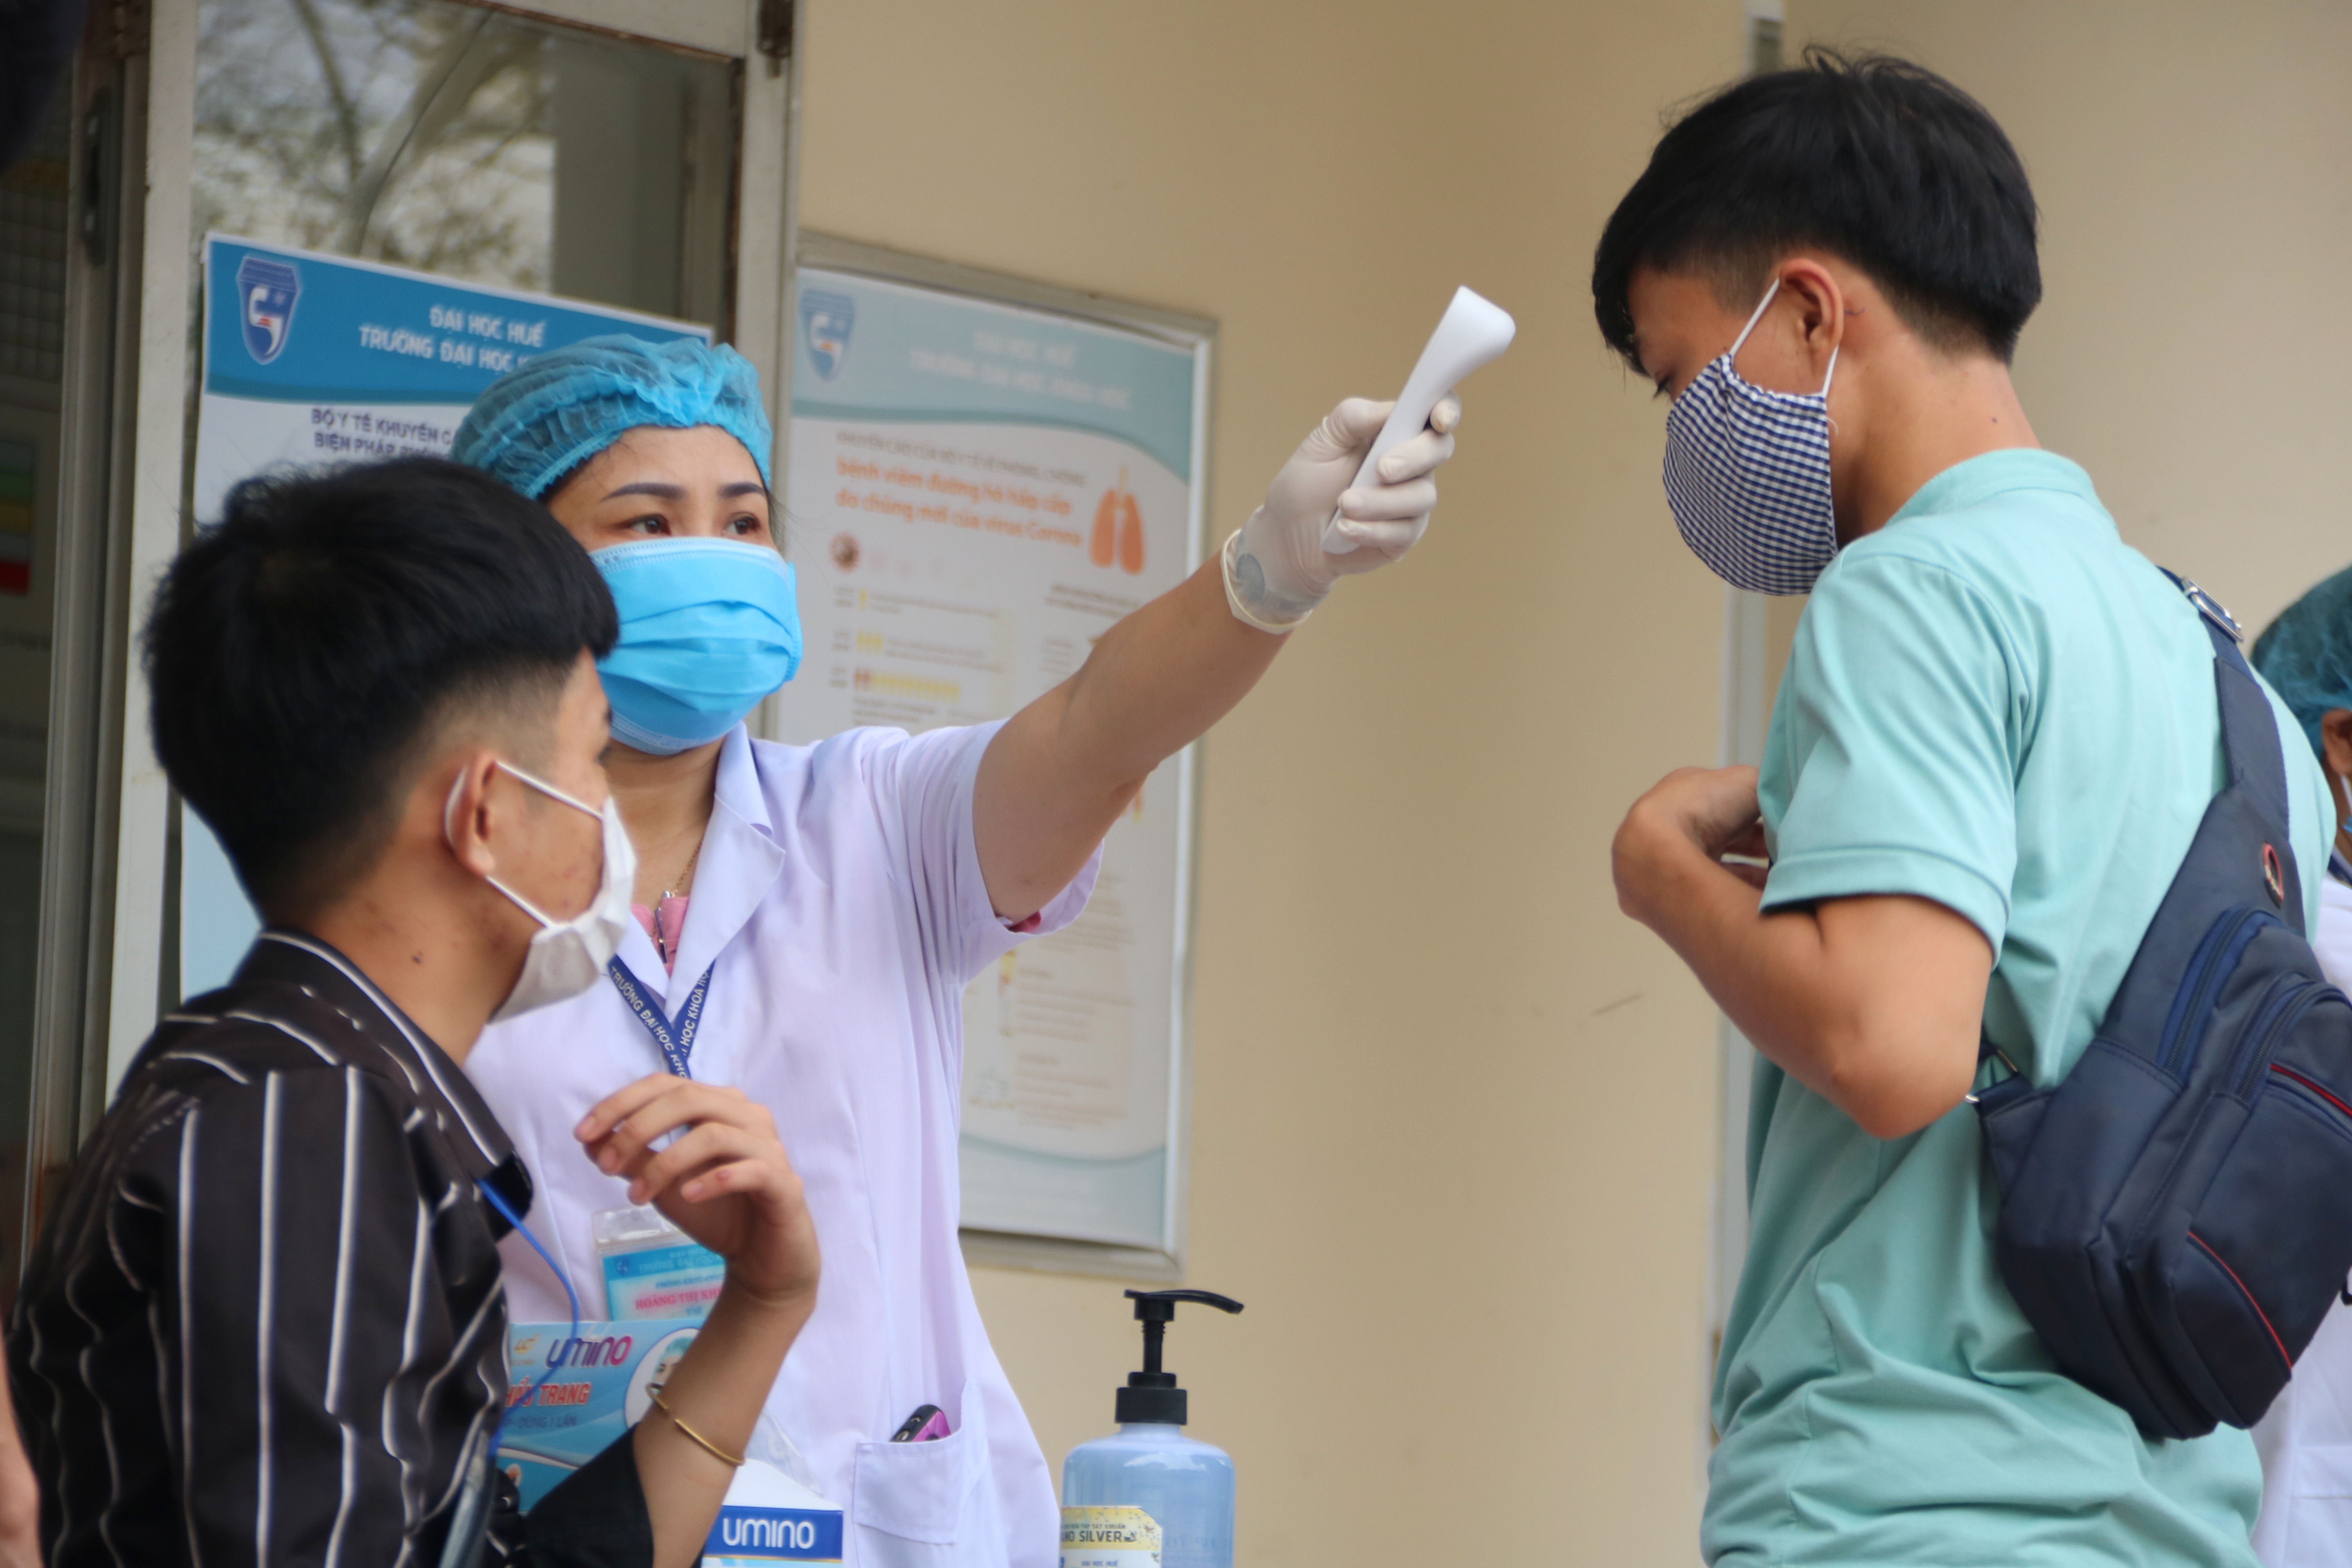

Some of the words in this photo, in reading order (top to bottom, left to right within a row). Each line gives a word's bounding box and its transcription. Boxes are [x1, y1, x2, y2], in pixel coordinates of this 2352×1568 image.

[430, 304, 464, 334] ĐẠI
[468, 314, 503, 341] HỌC
[507, 318, 545, 348] HUẾ
[359, 323, 433, 359] TRƯỜNG
[440, 339, 474, 368] ĐẠI
[479, 347, 512, 375] HỌC
[312, 408, 335, 428] BỘ
[338, 413, 347, 427] Y
[352, 413, 371, 432] TẾ
[375, 418, 438, 443] KHUYẾN
[315, 432, 351, 452] BIỆN
[354, 437, 396, 456] PHÁP
[984, 515, 1023, 537] virus
[1027, 521, 1083, 548] Corona
[611, 966, 644, 1011] TRƯỜNG
[640, 1010, 659, 1029] ĐẠI
[653, 1026, 675, 1051] HỌC
[687, 988, 704, 1019] KHOA
[680, 1019, 695, 1046] HỌC
[635, 1294, 676, 1310] HOÀNG
[678, 1291, 699, 1303] THỊ
[537, 1382, 592, 1406] TRANG
[1079, 1531, 1122, 1542] SILVER
